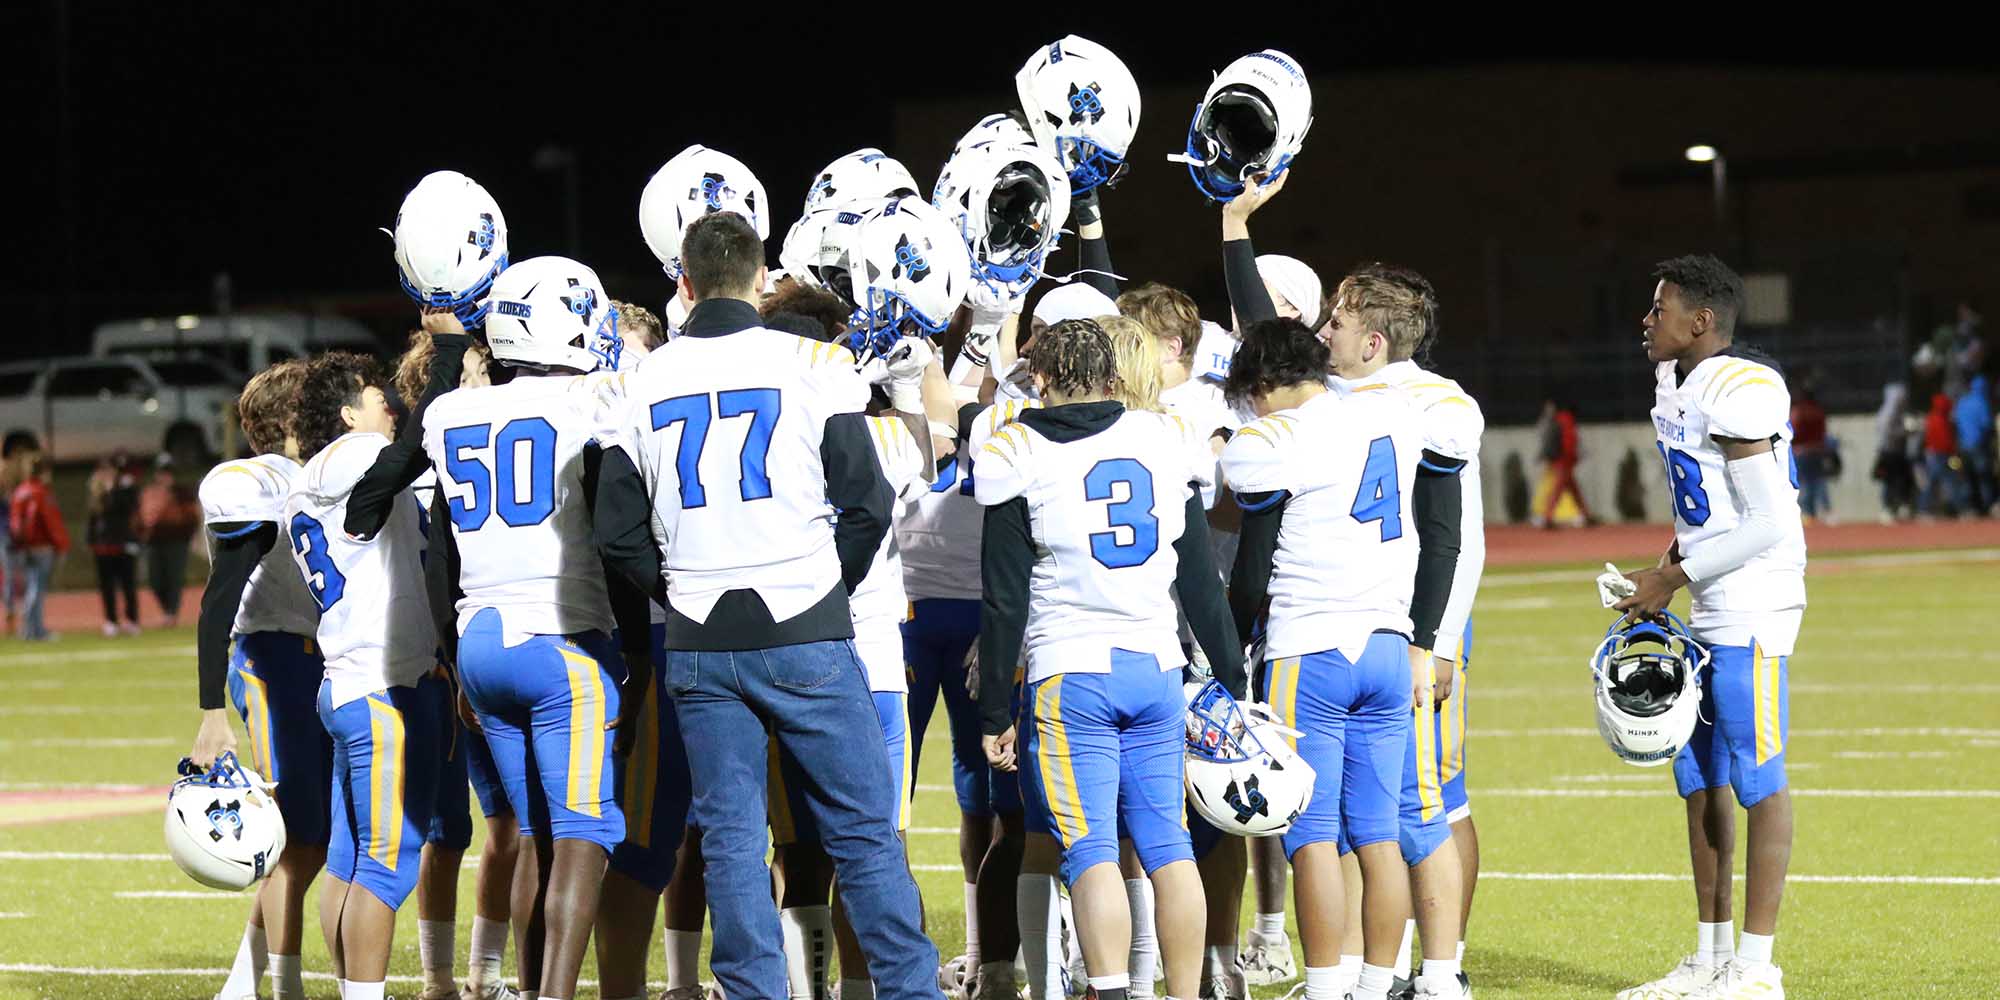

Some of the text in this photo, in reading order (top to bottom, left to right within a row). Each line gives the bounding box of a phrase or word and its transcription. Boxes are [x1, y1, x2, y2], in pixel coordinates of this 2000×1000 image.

[1211, 352, 1233, 370] TH
[443, 416, 558, 533] 50
[649, 387, 782, 510] 77
[1349, 434, 1403, 543] 4
[1083, 457, 1159, 570] 3
[1627, 729, 1659, 737] XENITH
